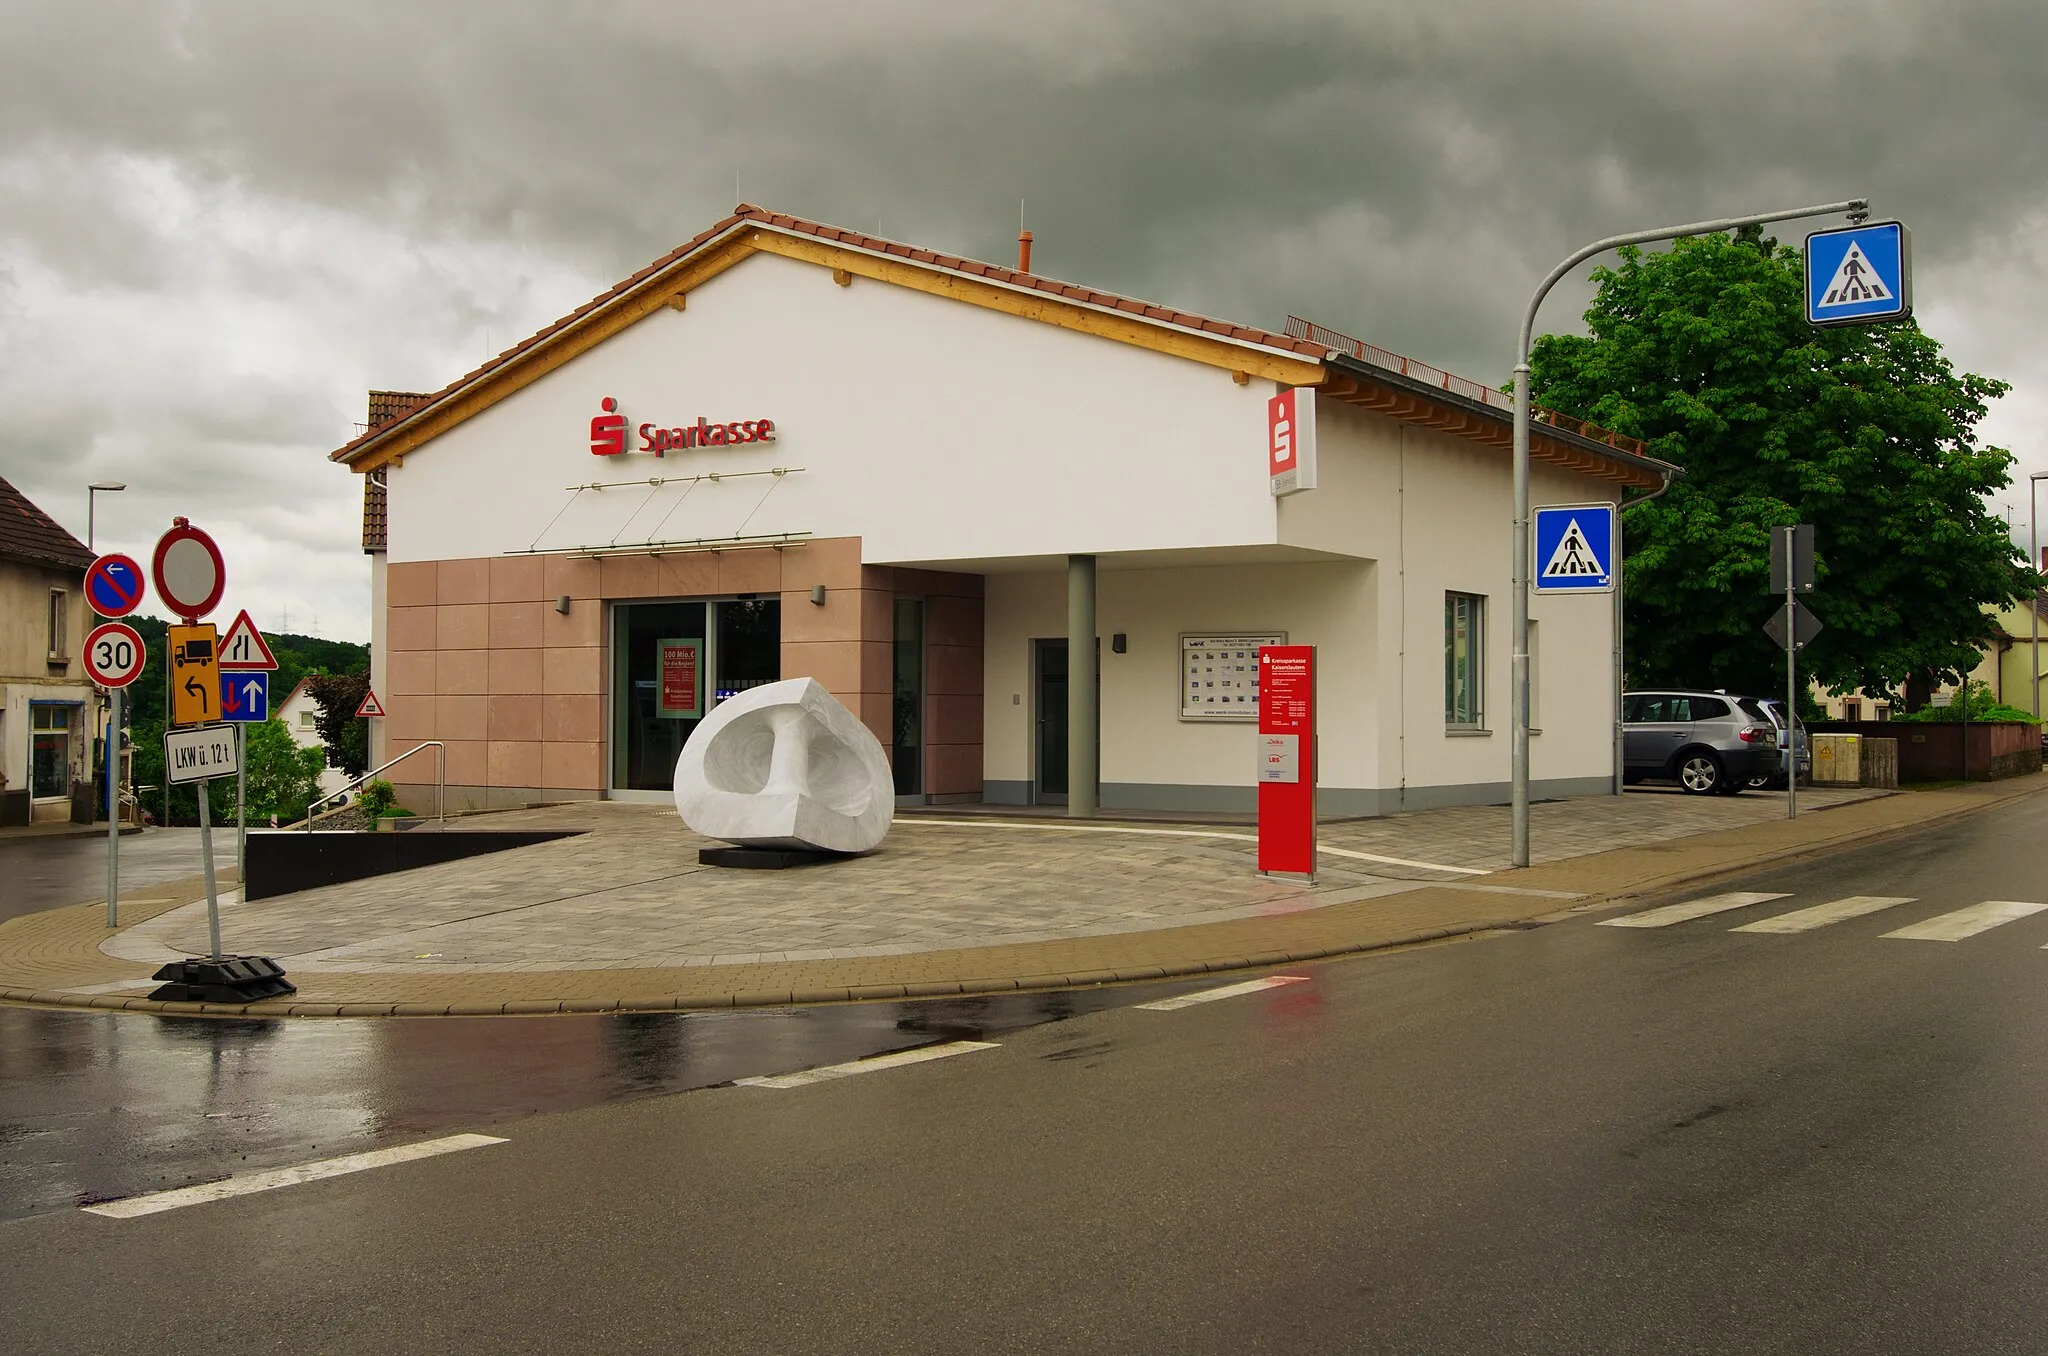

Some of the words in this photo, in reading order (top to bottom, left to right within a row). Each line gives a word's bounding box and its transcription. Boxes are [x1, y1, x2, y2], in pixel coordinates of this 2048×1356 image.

[638, 416, 776, 458] Sparkasse
[97, 642, 131, 669] 30
[175, 746, 196, 769] LKW
[199, 745, 209, 766] ü.
[211, 743, 222, 764] 12
[224, 743, 229, 762] t
